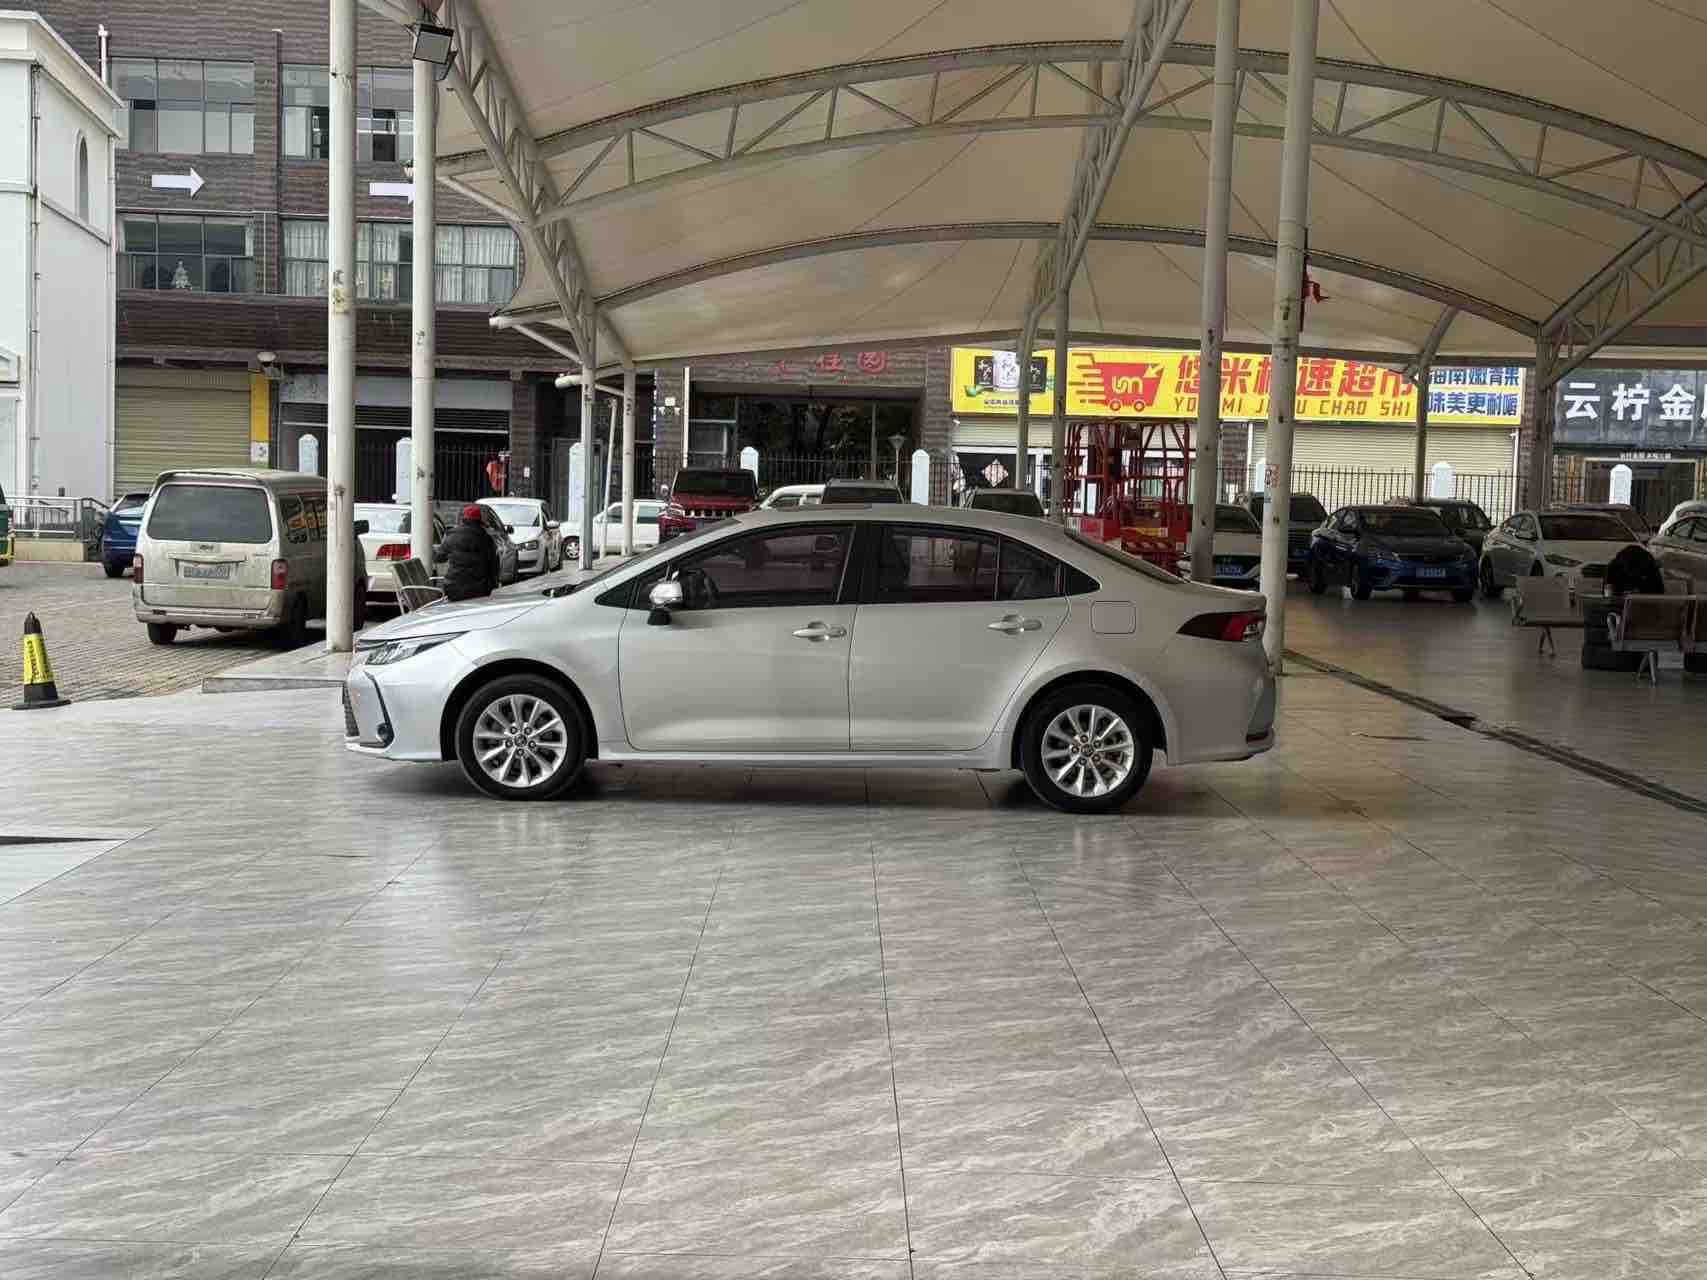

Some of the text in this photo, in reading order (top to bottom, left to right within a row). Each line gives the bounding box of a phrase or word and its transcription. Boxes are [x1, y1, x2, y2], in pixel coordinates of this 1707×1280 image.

[1175, 397, 1243, 413] YOMI
[1319, 399, 1368, 416] CHAO
[1379, 400, 1411, 416] SHI
[1563, 382, 1707, 421] 云柠金
